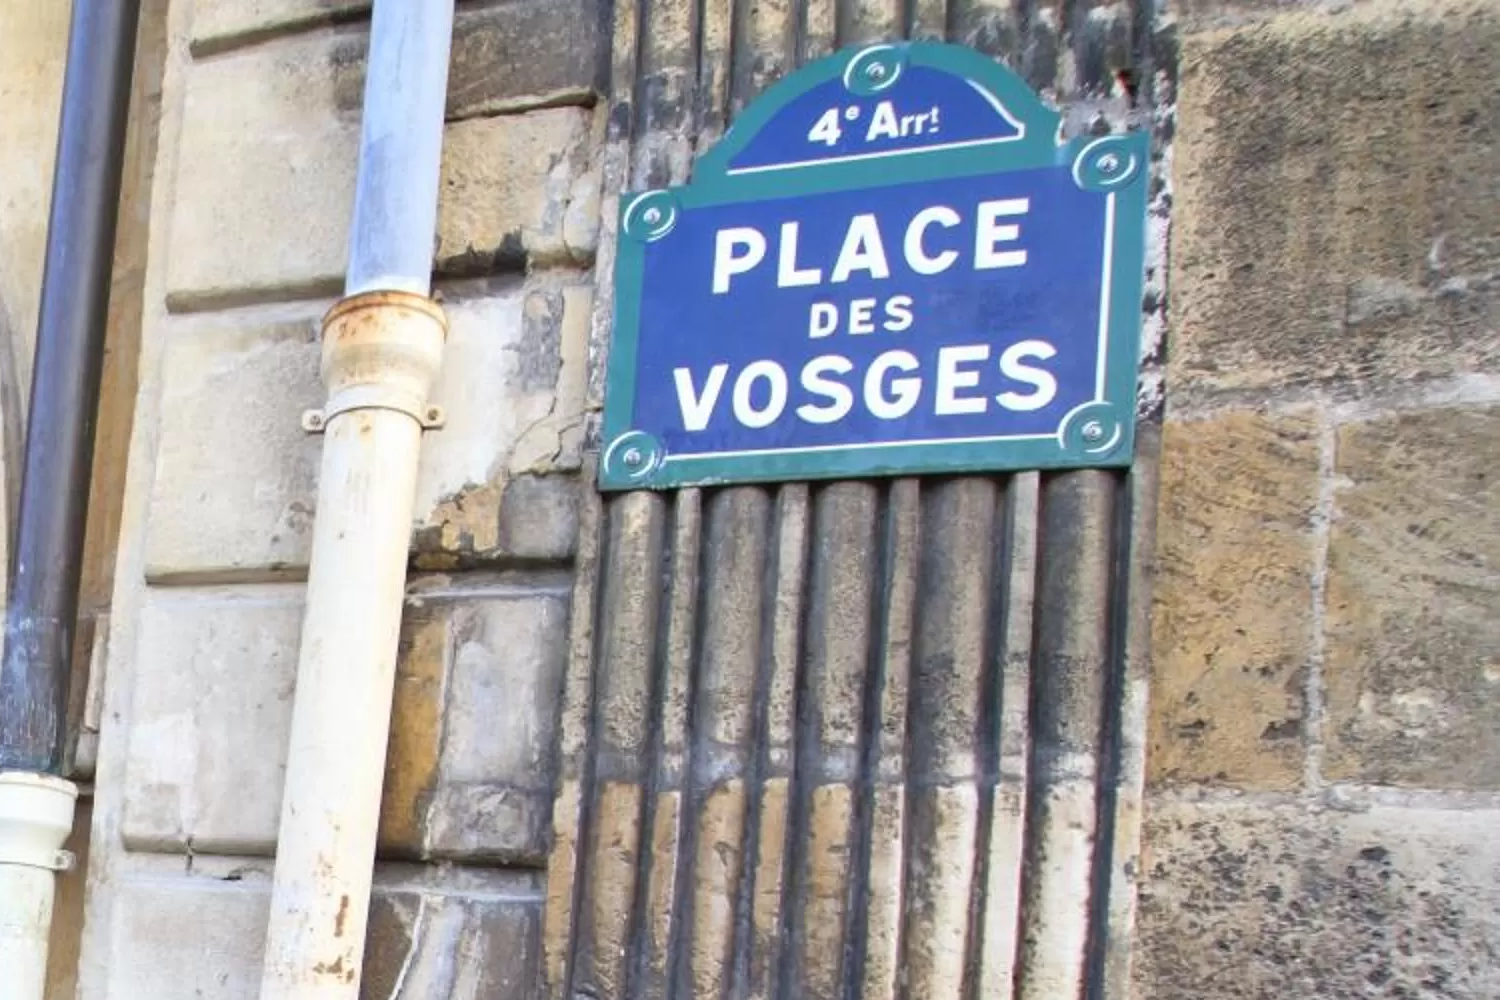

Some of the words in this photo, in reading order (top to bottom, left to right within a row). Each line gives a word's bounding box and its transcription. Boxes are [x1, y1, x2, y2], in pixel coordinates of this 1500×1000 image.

[712, 197, 1030, 294] PLACE
[808, 295, 915, 339] DES
[673, 339, 1058, 432] VOSGES
